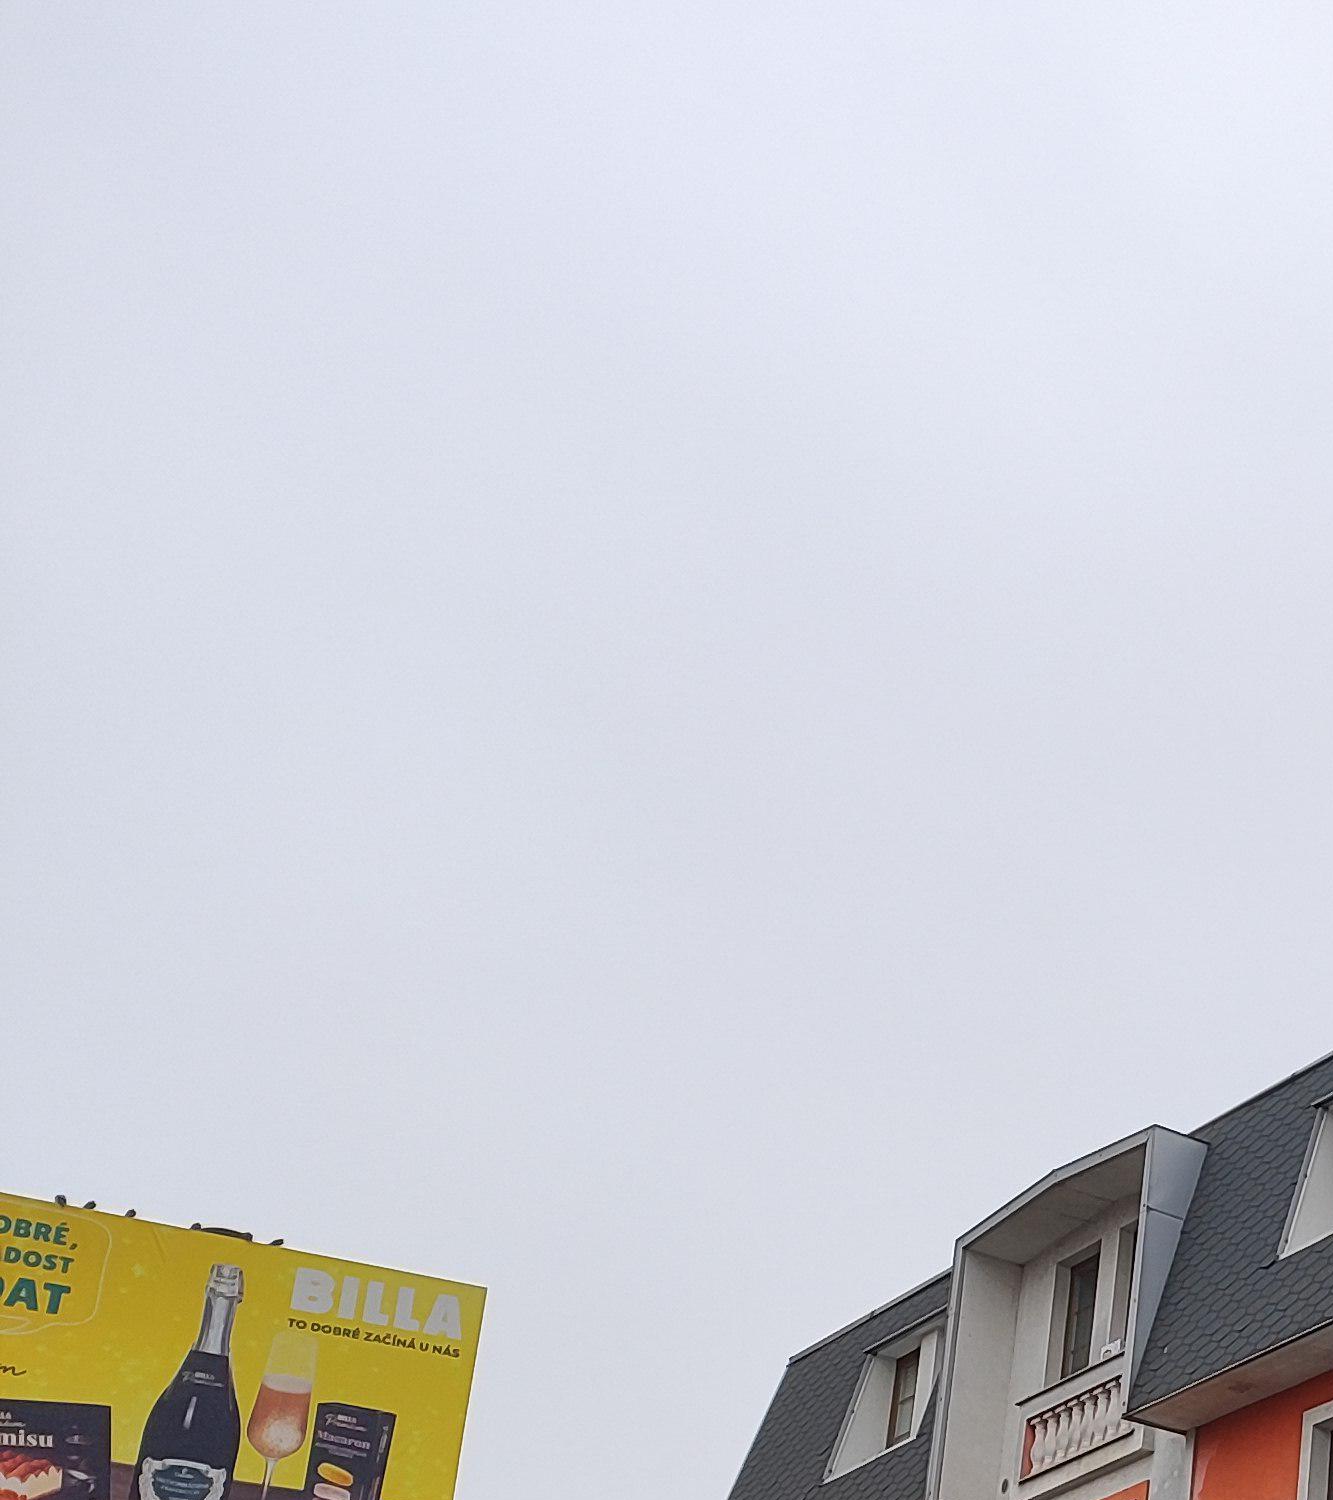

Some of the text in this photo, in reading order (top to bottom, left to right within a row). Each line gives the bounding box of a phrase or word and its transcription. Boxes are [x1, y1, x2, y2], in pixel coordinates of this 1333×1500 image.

[4, 1246, 75, 1273] DOST
[0, 1276, 71, 1314] AT
[290, 1267, 462, 1341] BILLA
[288, 1318, 460, 1358] TO DOBRÉ ZAČÍNÁ U NÁS
